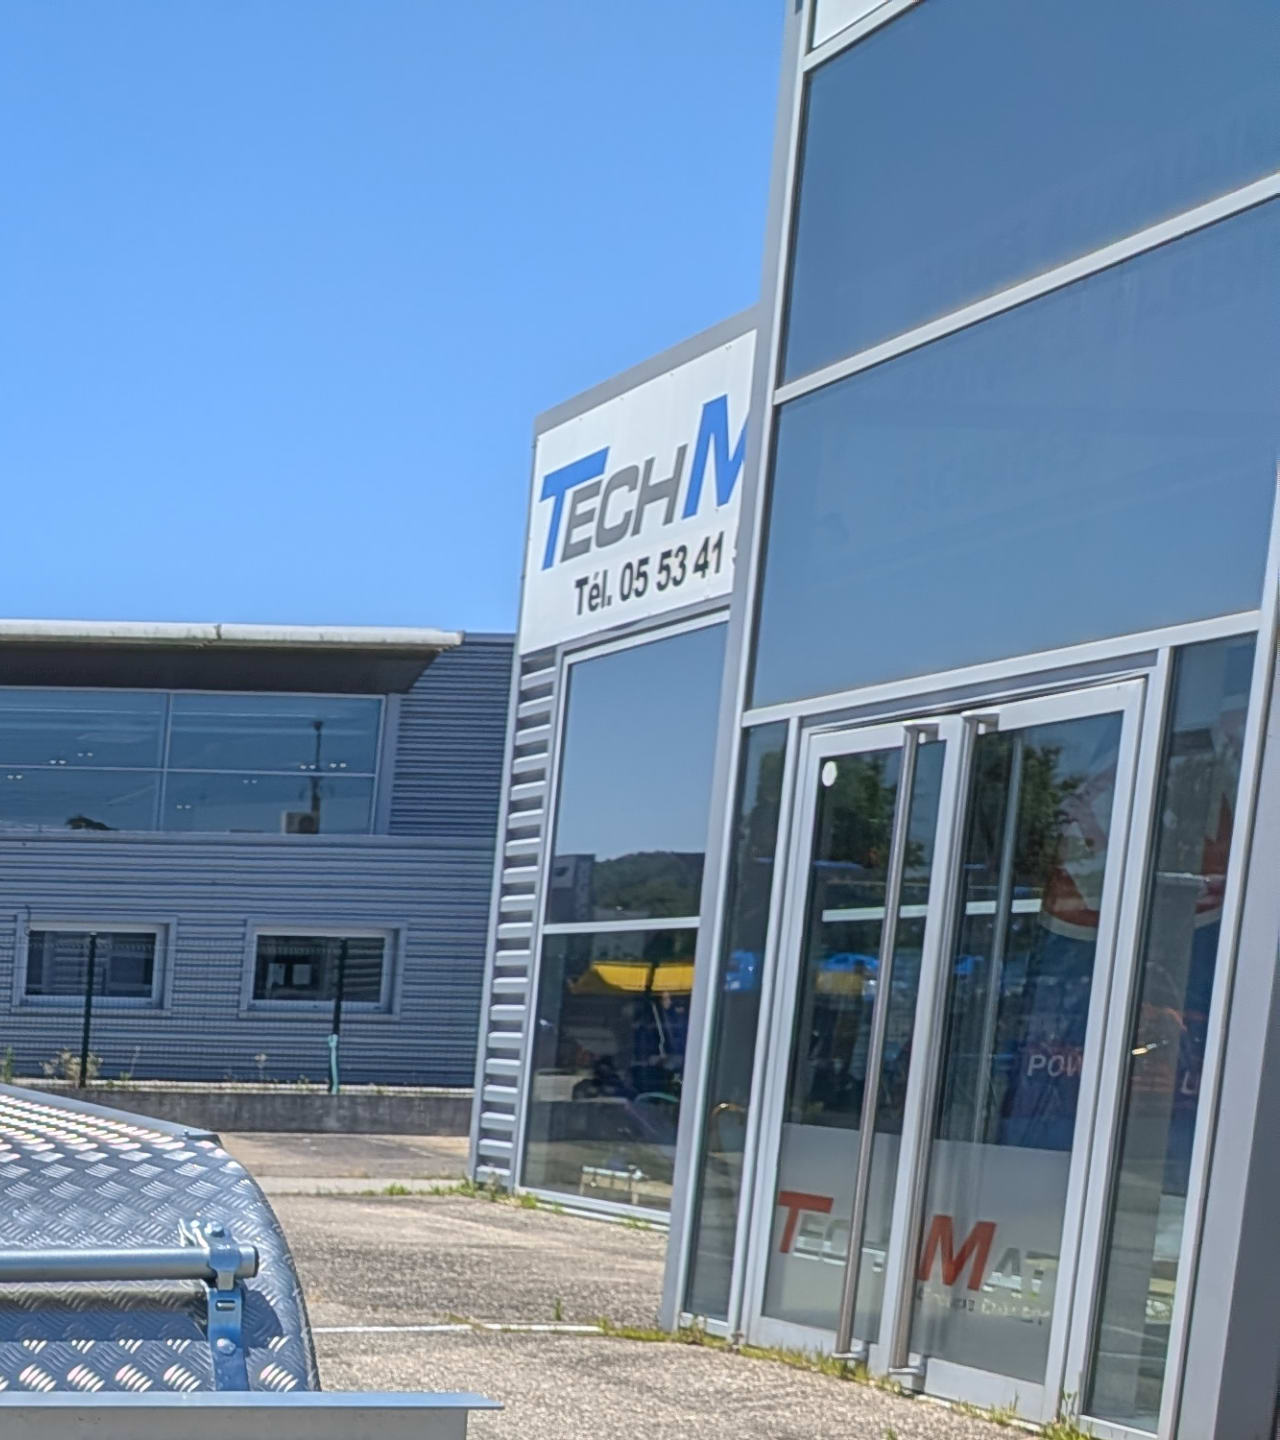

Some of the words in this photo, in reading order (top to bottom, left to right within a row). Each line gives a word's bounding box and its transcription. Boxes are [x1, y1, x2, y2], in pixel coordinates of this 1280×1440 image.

[575, 569, 612, 616] Tél.
[620, 556, 650, 602] 05
[656, 544, 688, 592] 53
[693, 531, 725, 579] 41
